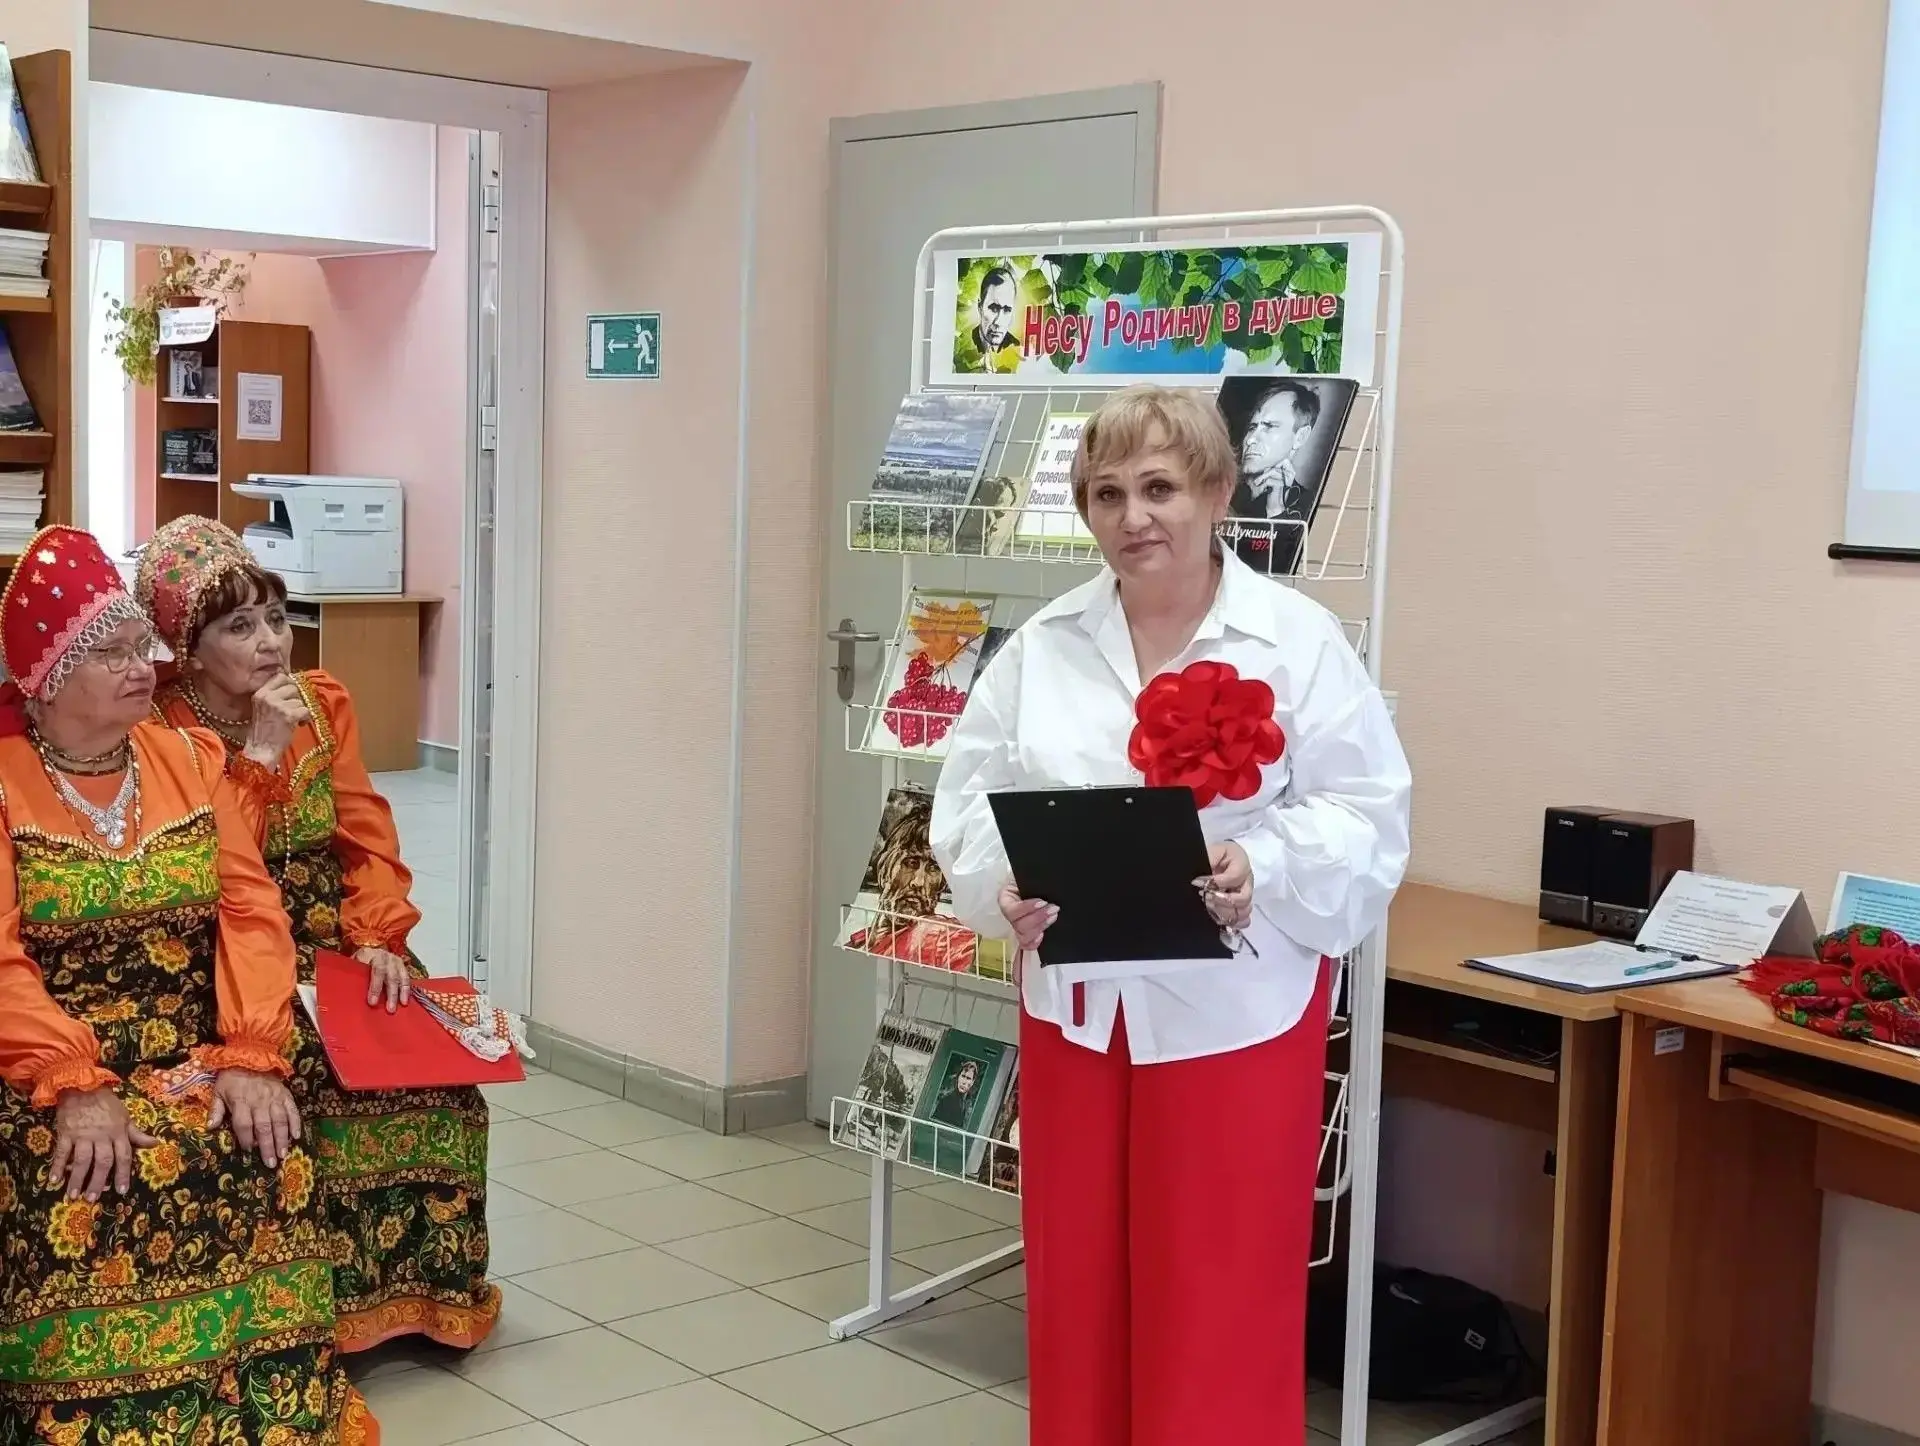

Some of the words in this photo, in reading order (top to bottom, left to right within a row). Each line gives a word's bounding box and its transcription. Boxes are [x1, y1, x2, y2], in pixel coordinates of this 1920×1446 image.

[1024, 304, 1094, 365] Несу
[1102, 300, 1214, 352] Родину
[1222, 301, 1240, 332] в
[1248, 293, 1337, 336] душе
[1055, 450, 1077, 465] крас
[1034, 472, 1070, 486] трево
[1028, 489, 1067, 505] Василий
